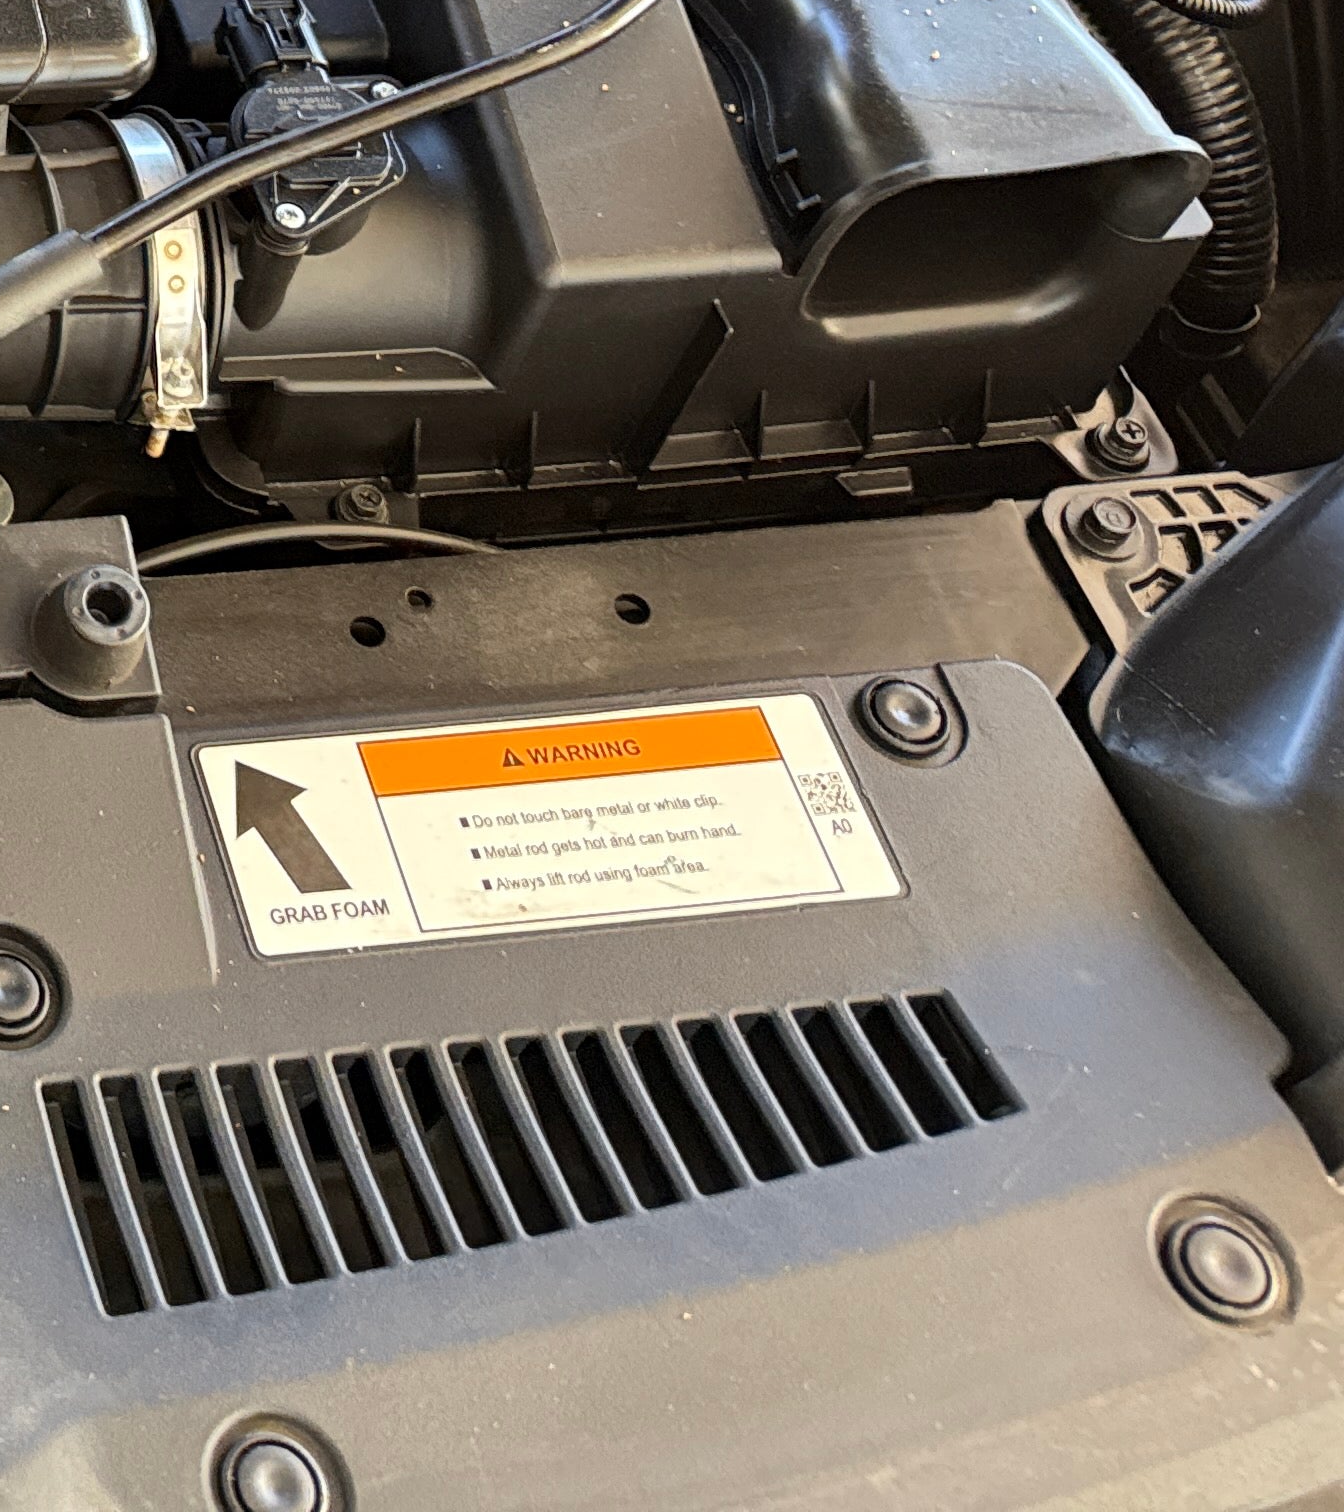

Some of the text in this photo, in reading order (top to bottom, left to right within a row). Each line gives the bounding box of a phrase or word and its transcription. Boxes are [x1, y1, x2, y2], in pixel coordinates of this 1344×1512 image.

[526, 739, 641, 765] WARNING
[471, 814, 493, 829] Do
[496, 812, 519, 826] not
[521, 807, 559, 824] touch
[561, 805, 593, 821] bare
[596, 801, 634, 817] metal
[637, 801, 651, 813] or
[653, 795, 691, 811] white
[831, 818, 853, 835] A0
[483, 844, 523, 860] Metal
[525, 841, 548, 856] rod
[552, 838, 582, 857] gets
[582, 834, 607, 851] hot
[610, 832, 636, 847] and
[638, 832, 665, 845] can
[666, 827, 700, 843] burn
[496, 873, 546, 893] Always
[546, 870, 566, 887] lift
[568, 868, 592, 884] rod
[594, 865, 632, 883] using
[633, 862, 669, 878] foam
[270, 898, 390, 925] GRAB FOAM
